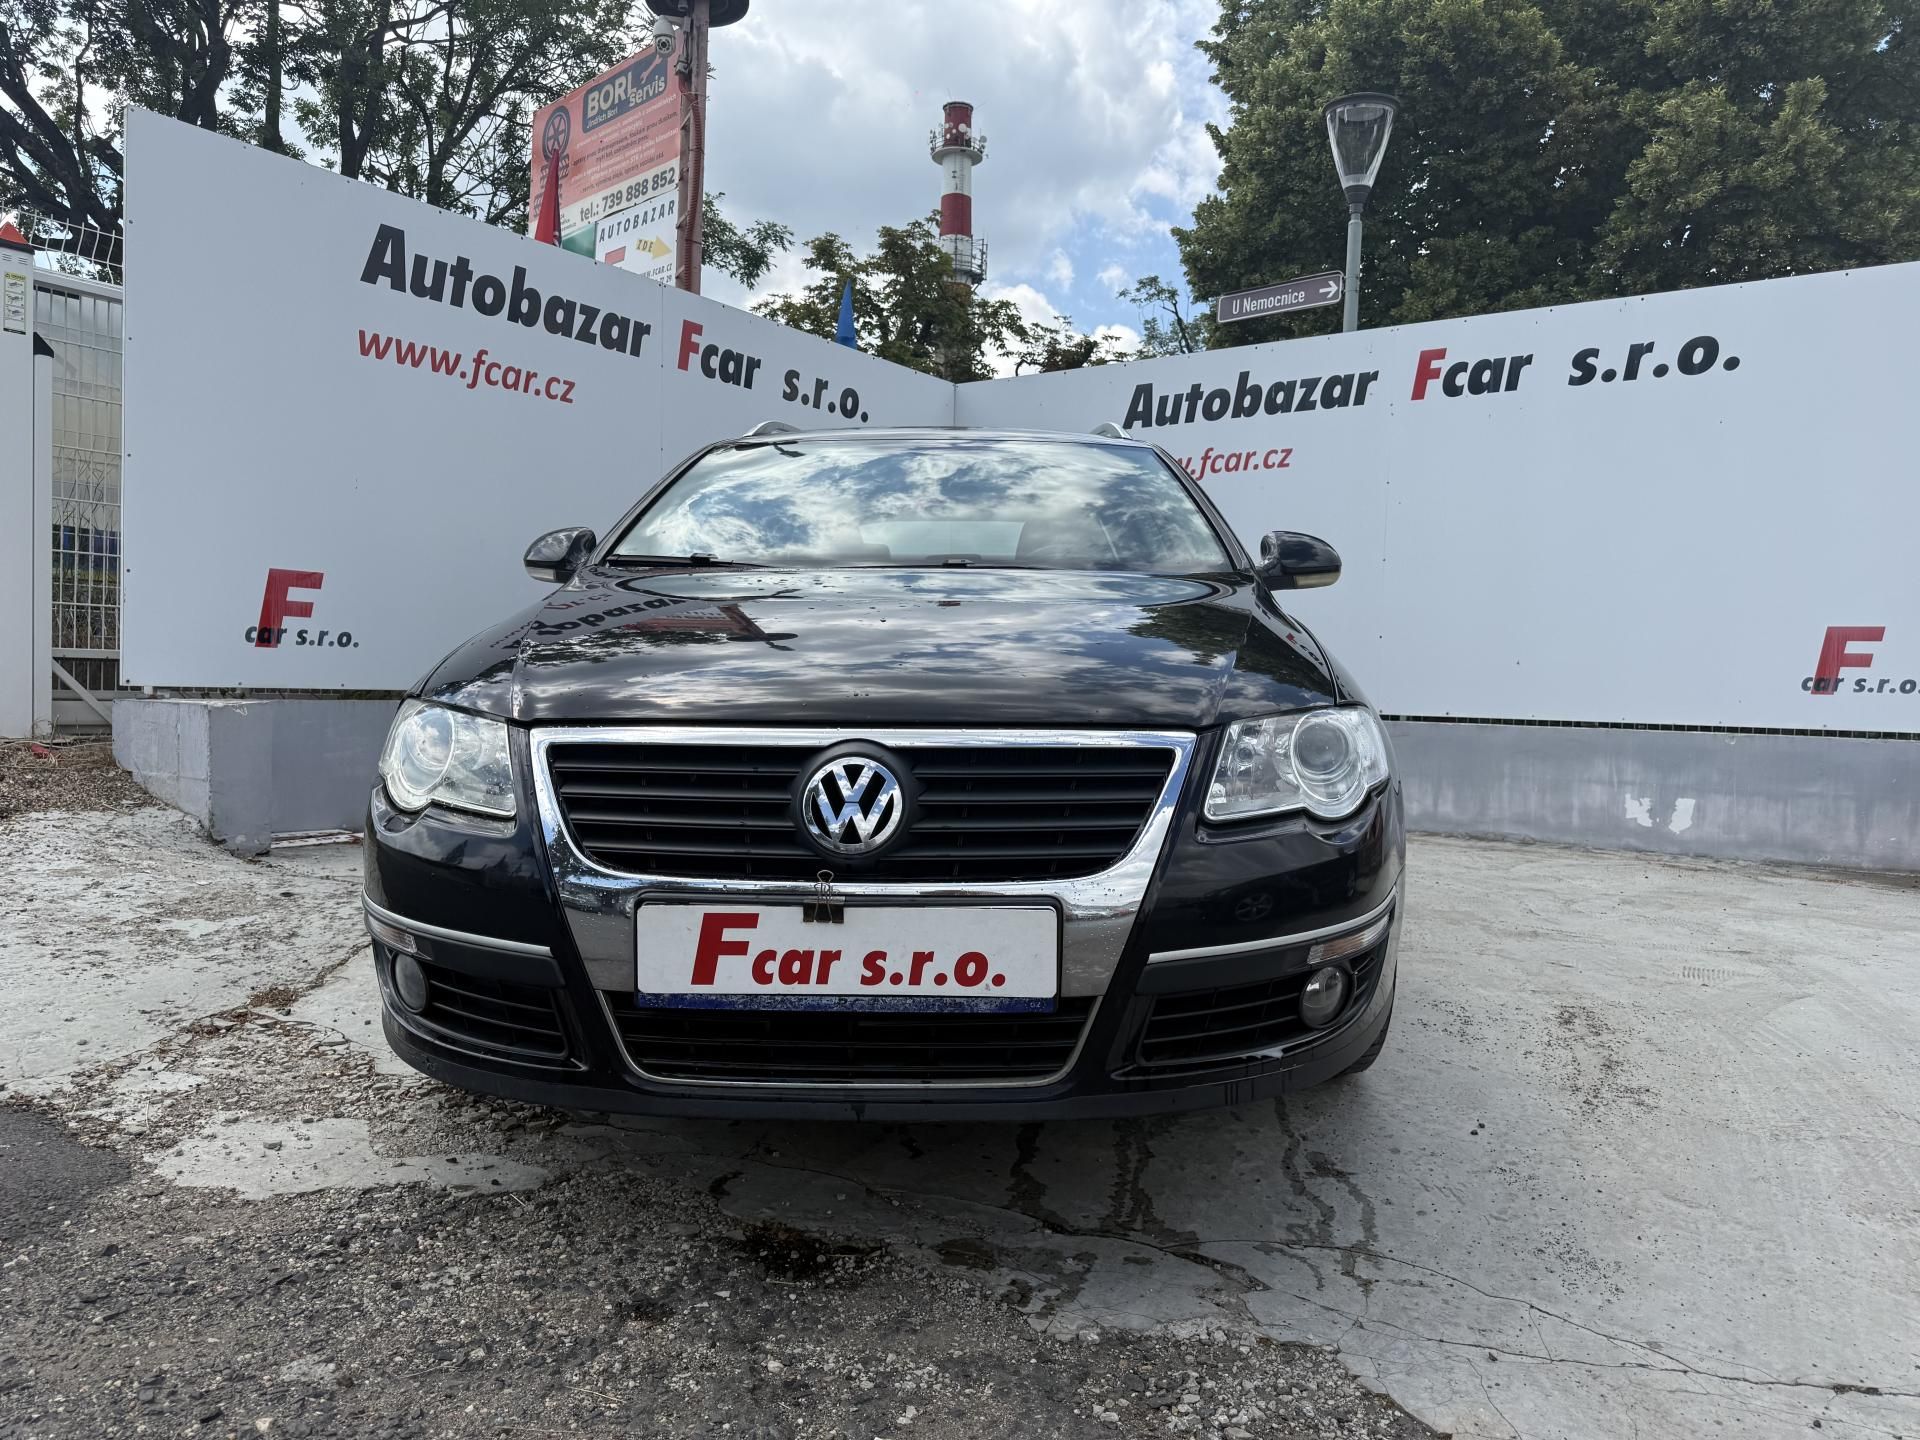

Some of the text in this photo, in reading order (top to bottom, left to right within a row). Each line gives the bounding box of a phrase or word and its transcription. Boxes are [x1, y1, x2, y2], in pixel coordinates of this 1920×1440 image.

[629, 75, 665, 106] servis
[580, 203, 599, 222] tel.:
[602, 189, 623, 212] 739
[626, 179, 648, 202] 888
[651, 167, 675, 191] 852
[599, 200, 675, 243] AUTOBAZAR
[636, 239, 653, 252] ZDE
[360, 223, 869, 423] Autobazar Fcar s.r.o.
[1232, 289, 1305, 315] U Nemocnice
[357, 329, 577, 404] www.fcar.cz
[1122, 335, 1742, 430] Autobazar Fcar s.r.o.
[296, 629, 360, 648] s.r.o.
[690, 912, 1007, 987] Fcar s.r.o.
